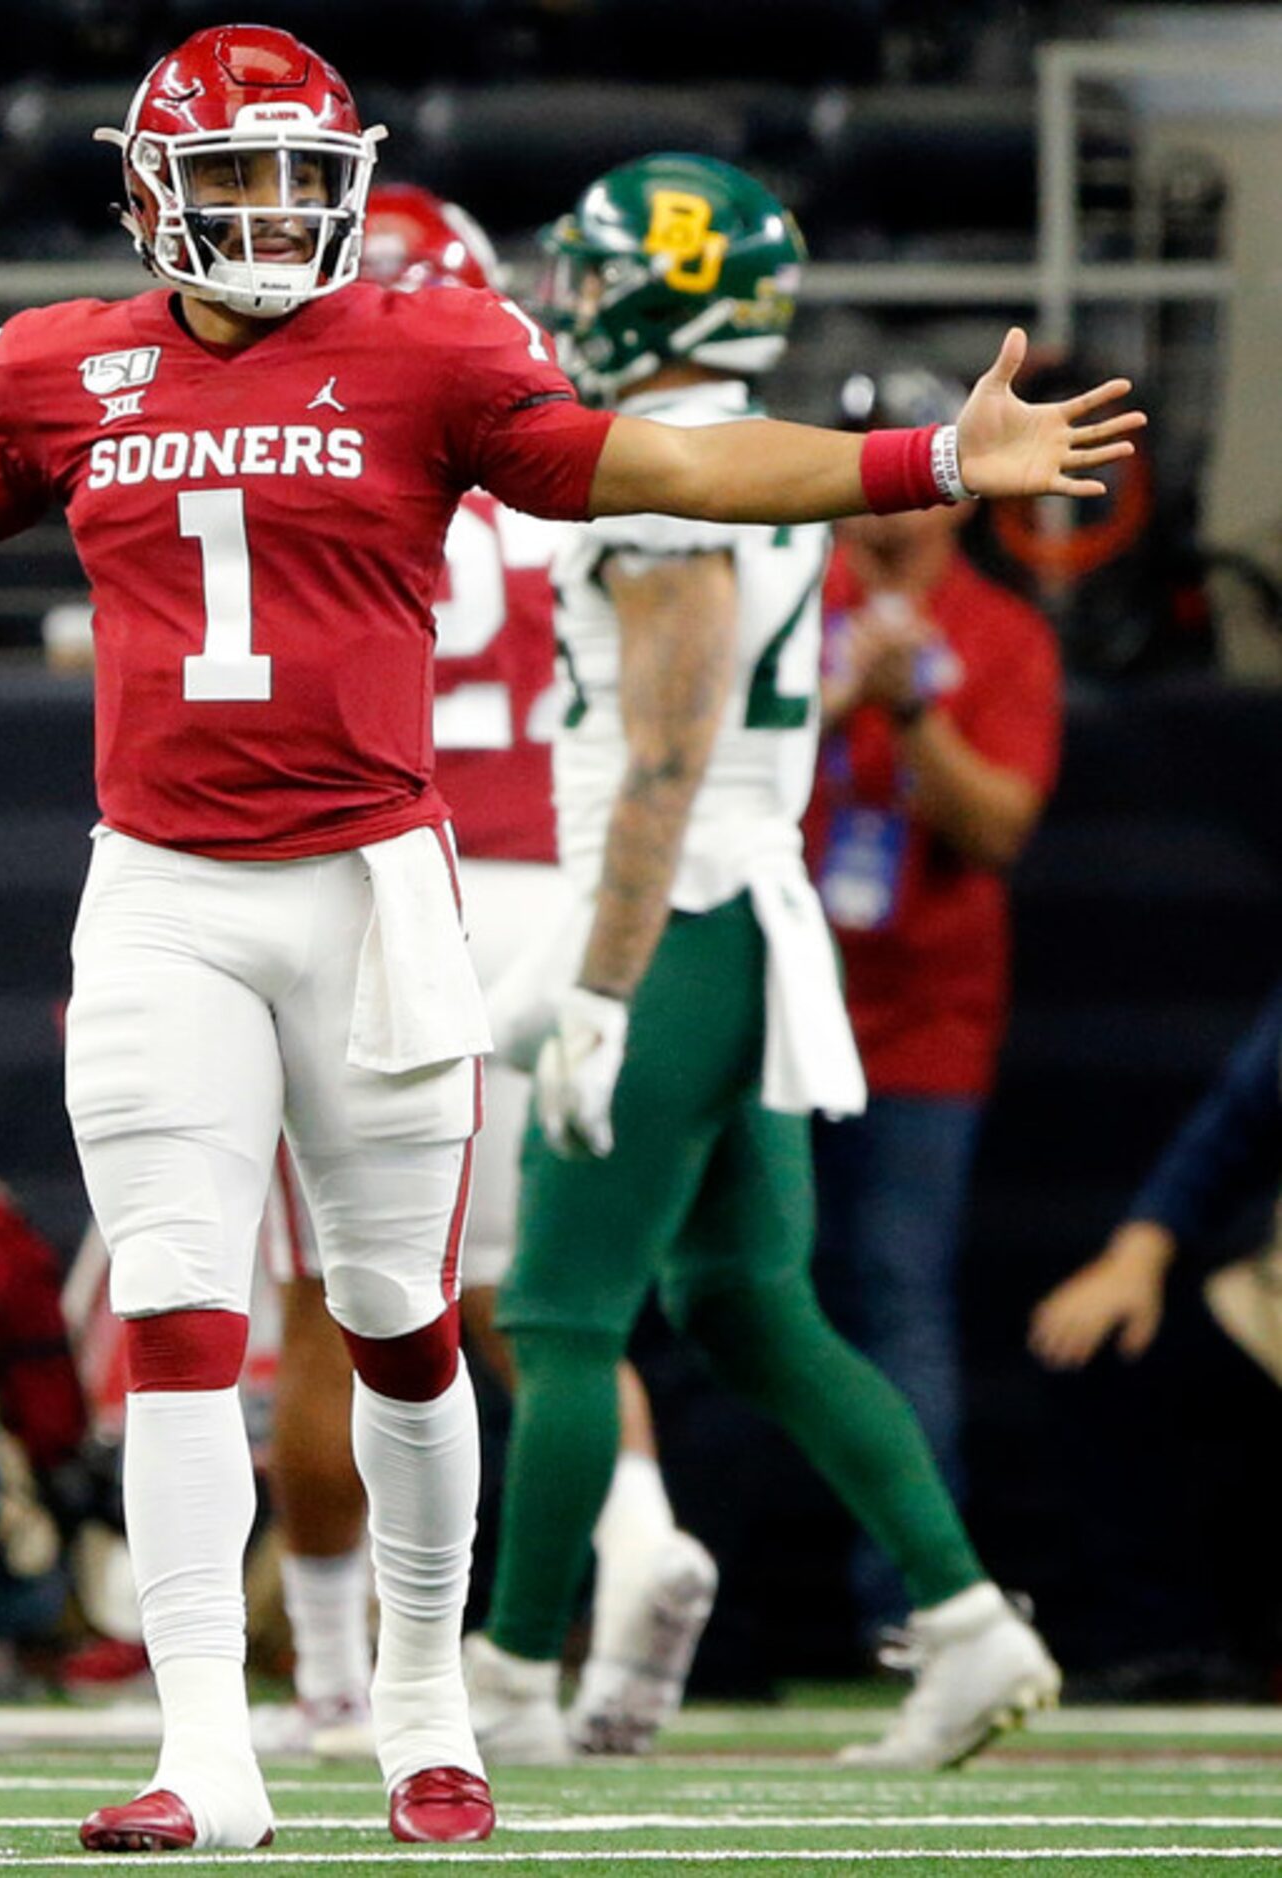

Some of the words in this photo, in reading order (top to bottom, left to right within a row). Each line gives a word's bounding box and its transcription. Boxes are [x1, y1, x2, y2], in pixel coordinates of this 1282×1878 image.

[644, 190, 730, 294] BU
[79, 346, 162, 395] 150
[88, 425, 364, 490] SOONERS
[177, 487, 272, 701] 1
